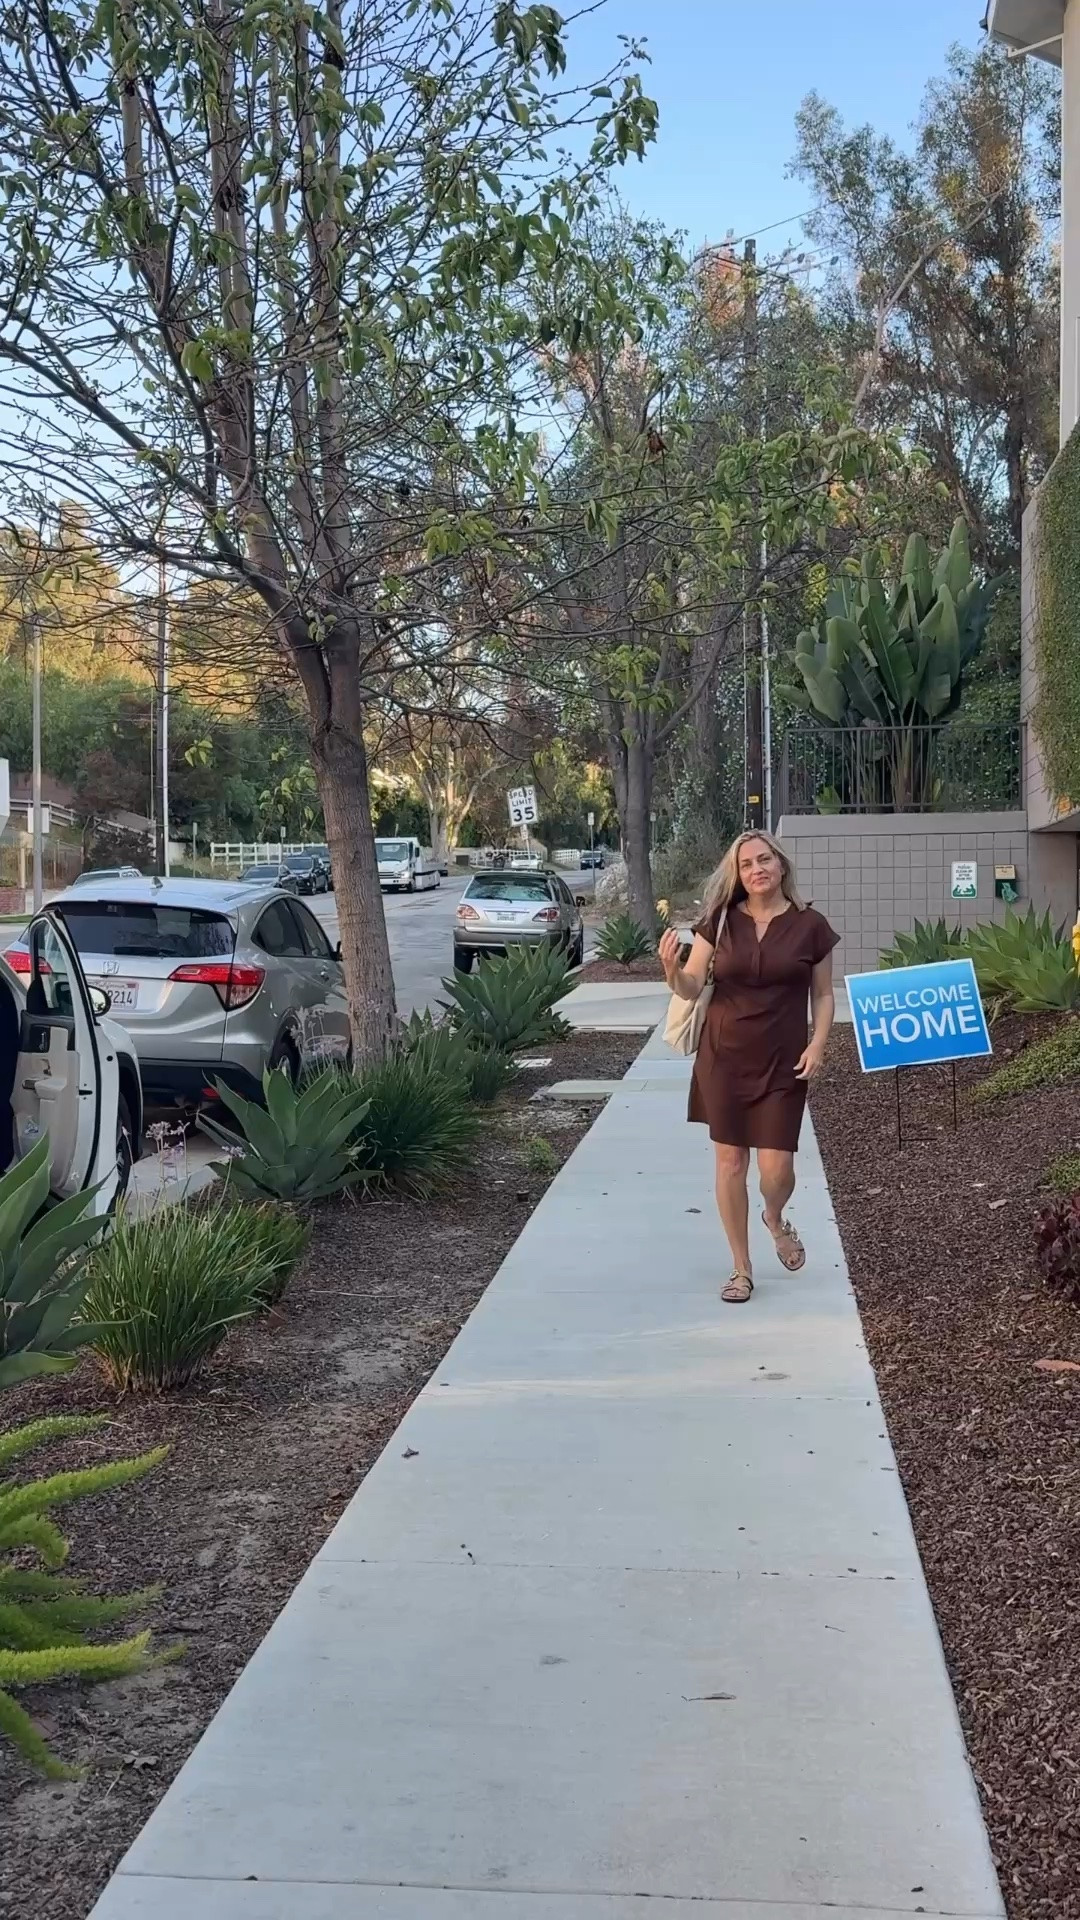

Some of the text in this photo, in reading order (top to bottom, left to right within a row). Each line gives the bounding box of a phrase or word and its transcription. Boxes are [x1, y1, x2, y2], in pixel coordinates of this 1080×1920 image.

[509, 789, 532, 799] SPED
[512, 797, 531, 807] LIMIT
[513, 806, 534, 822] 35
[857, 983, 973, 1014] WELCOME
[861, 1004, 981, 1048] HOME
